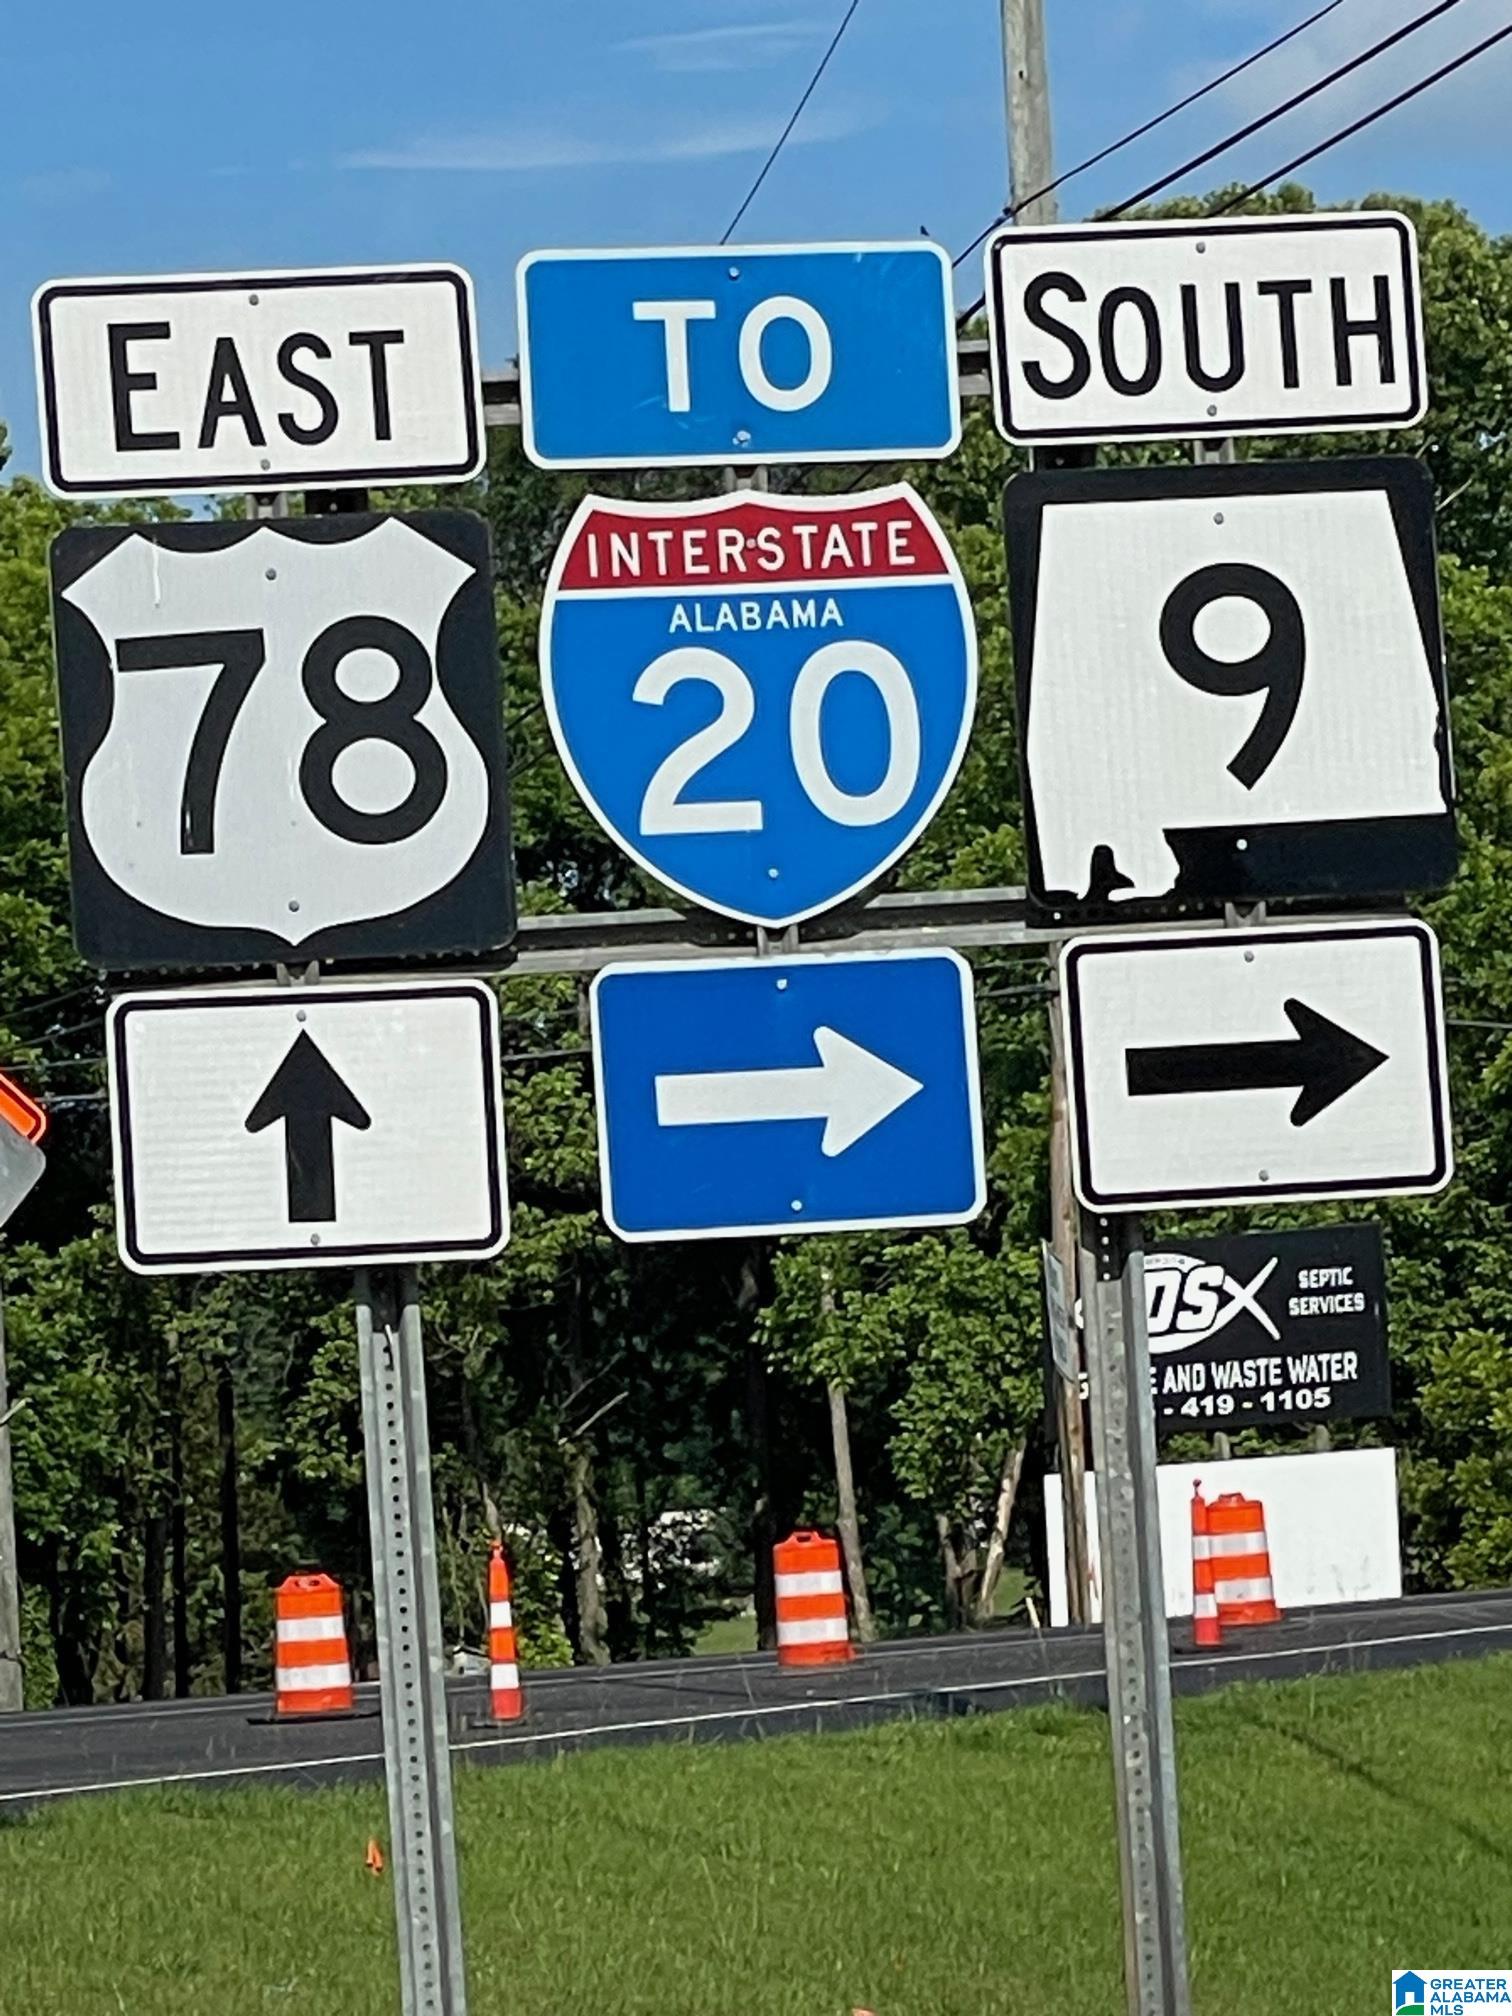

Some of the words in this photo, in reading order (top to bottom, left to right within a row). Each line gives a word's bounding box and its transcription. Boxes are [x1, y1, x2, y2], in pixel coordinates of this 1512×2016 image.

[632, 296, 832, 413] TO
[1021, 271, 1396, 400] SOUTH
[107, 320, 405, 453] EAST
[587, 519, 916, 579] INTERSTATE
[669, 597, 845, 634] ALABAMA
[1159, 562, 1306, 791] 9
[115, 615, 449, 856] 78
[632, 640, 921, 836] 20
[1288, 1292, 1366, 1317] SERVICES
[1298, 1266, 1354, 1289] SEPTIC
[1162, 1363, 1205, 1394] AND
[1210, 1357, 1283, 1390] WASTE
[1286, 1351, 1358, 1385] WATER
[1180, 1393, 1235, 1417] 419
[1260, 1387, 1332, 1412] 1105
